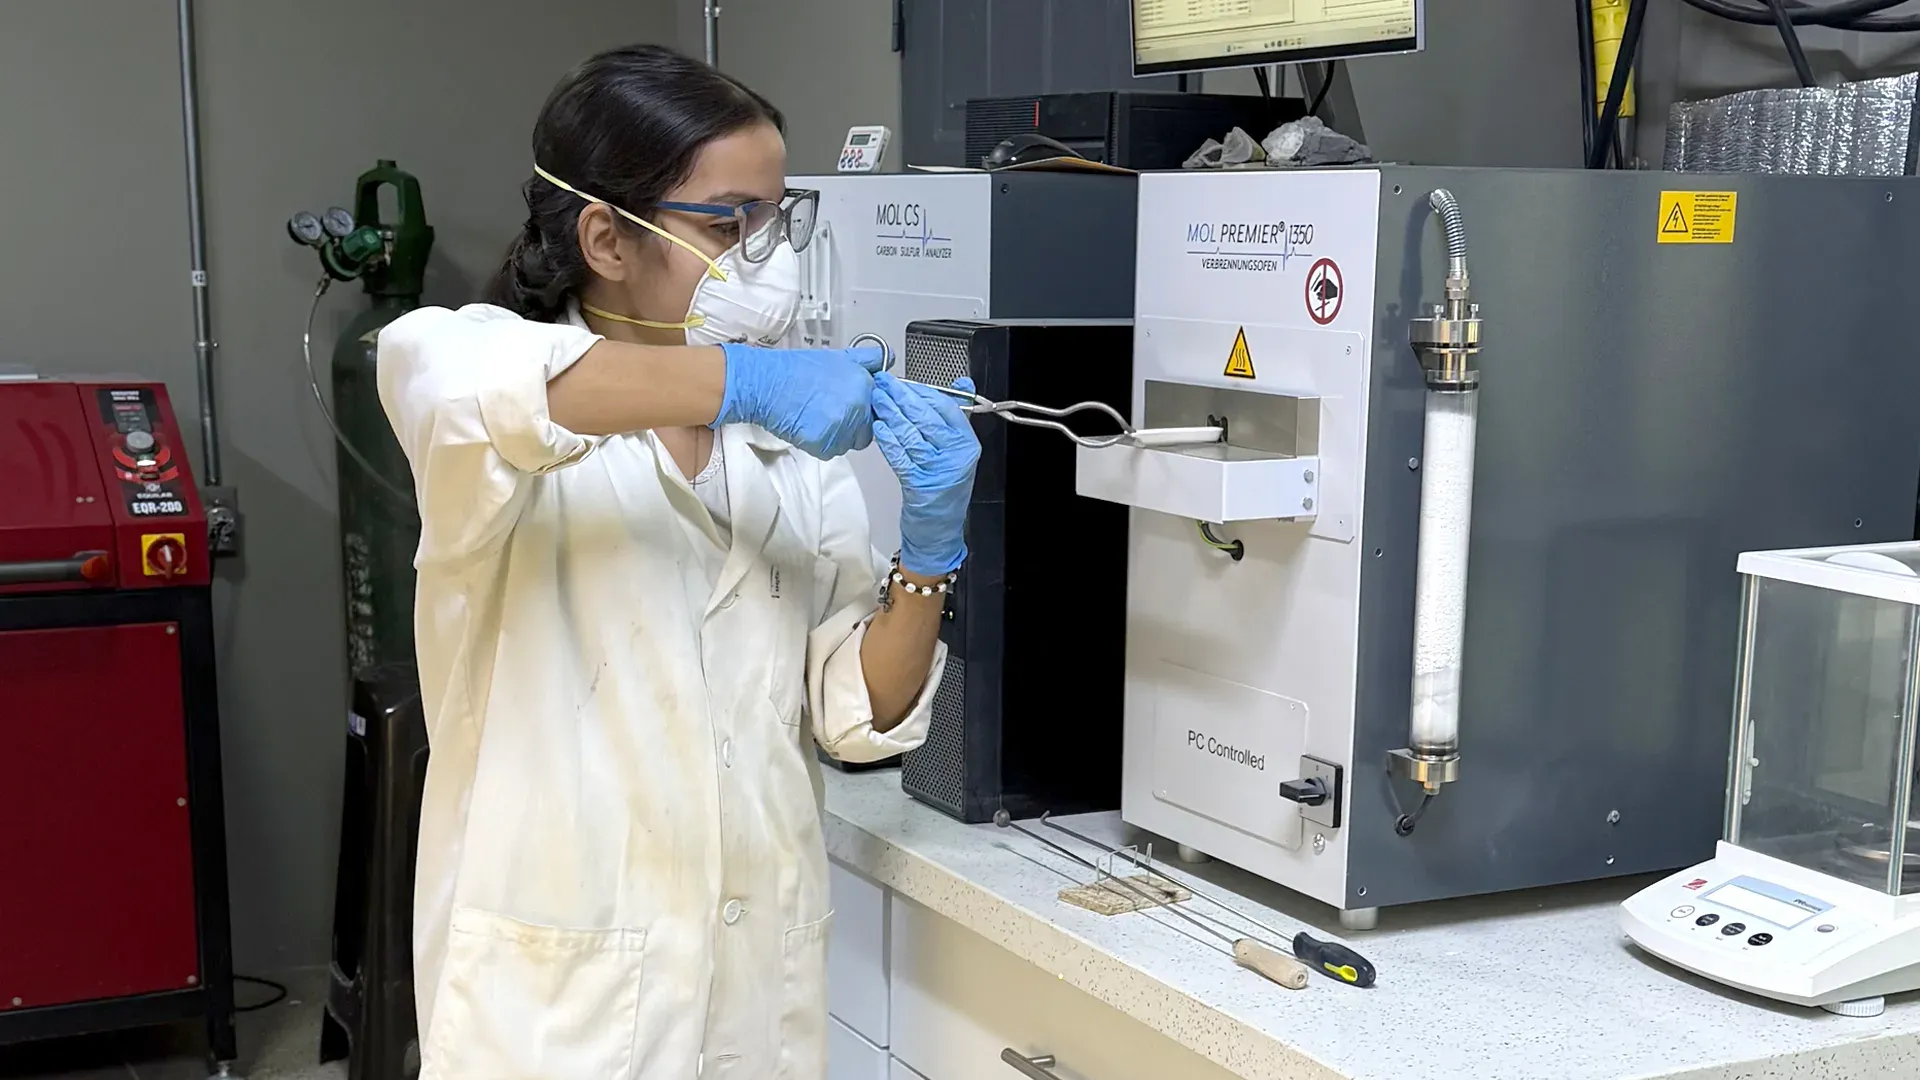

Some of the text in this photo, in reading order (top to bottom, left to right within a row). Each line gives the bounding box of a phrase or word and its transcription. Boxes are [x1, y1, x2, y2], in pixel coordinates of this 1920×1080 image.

[876, 203, 920, 226] MOL CS
[1187, 223, 1217, 243] MOL
[1288, 224, 1314, 245] 1350
[876, 245, 952, 259] CARBON SULFUR ANALYZER
[1201, 258, 1278, 272] VERBRENNUNGSOFEN
[131, 500, 183, 515] EQR-200
[1188, 729, 1265, 771] PC Controlled
